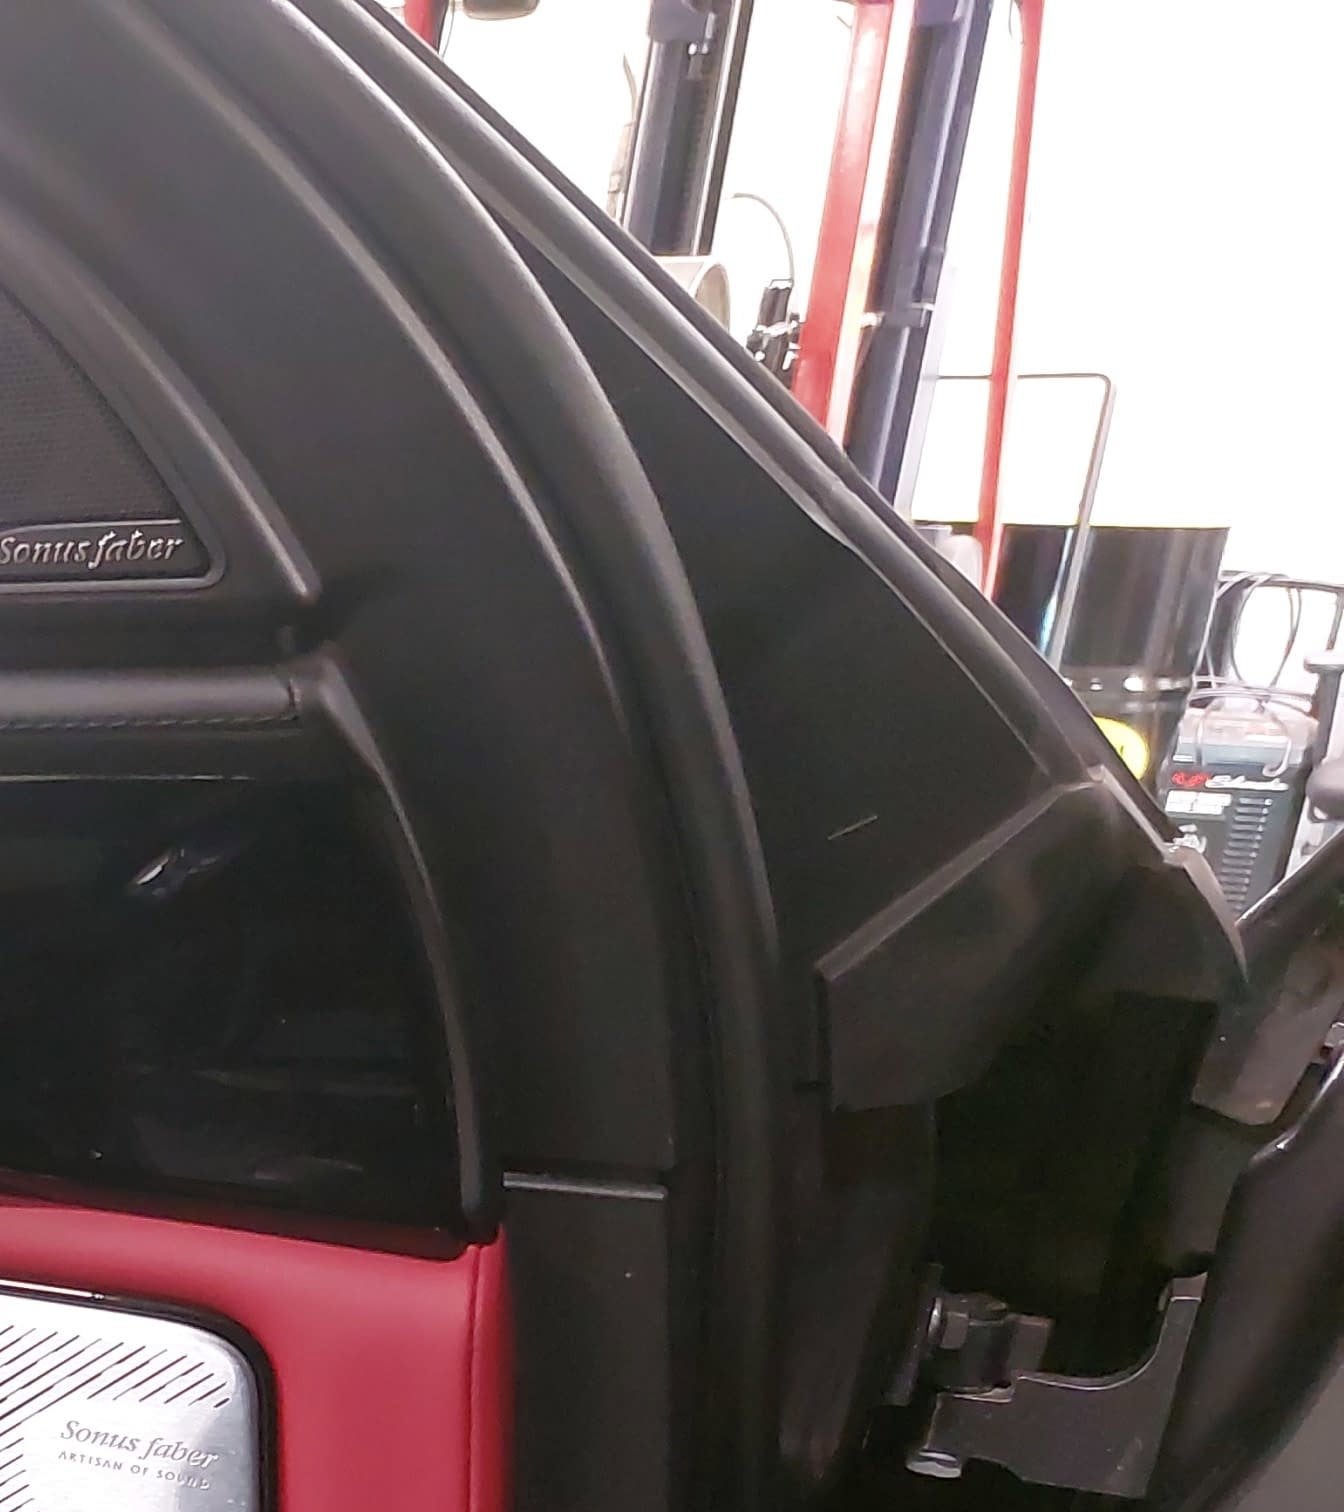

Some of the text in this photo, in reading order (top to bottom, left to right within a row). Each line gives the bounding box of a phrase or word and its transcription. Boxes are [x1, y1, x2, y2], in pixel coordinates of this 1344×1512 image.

[87, 529, 185, 570] faber
[60, 1419, 221, 1469] Sonus faber
[57, 1450, 211, 1490] ARTISAN OF SOUND
